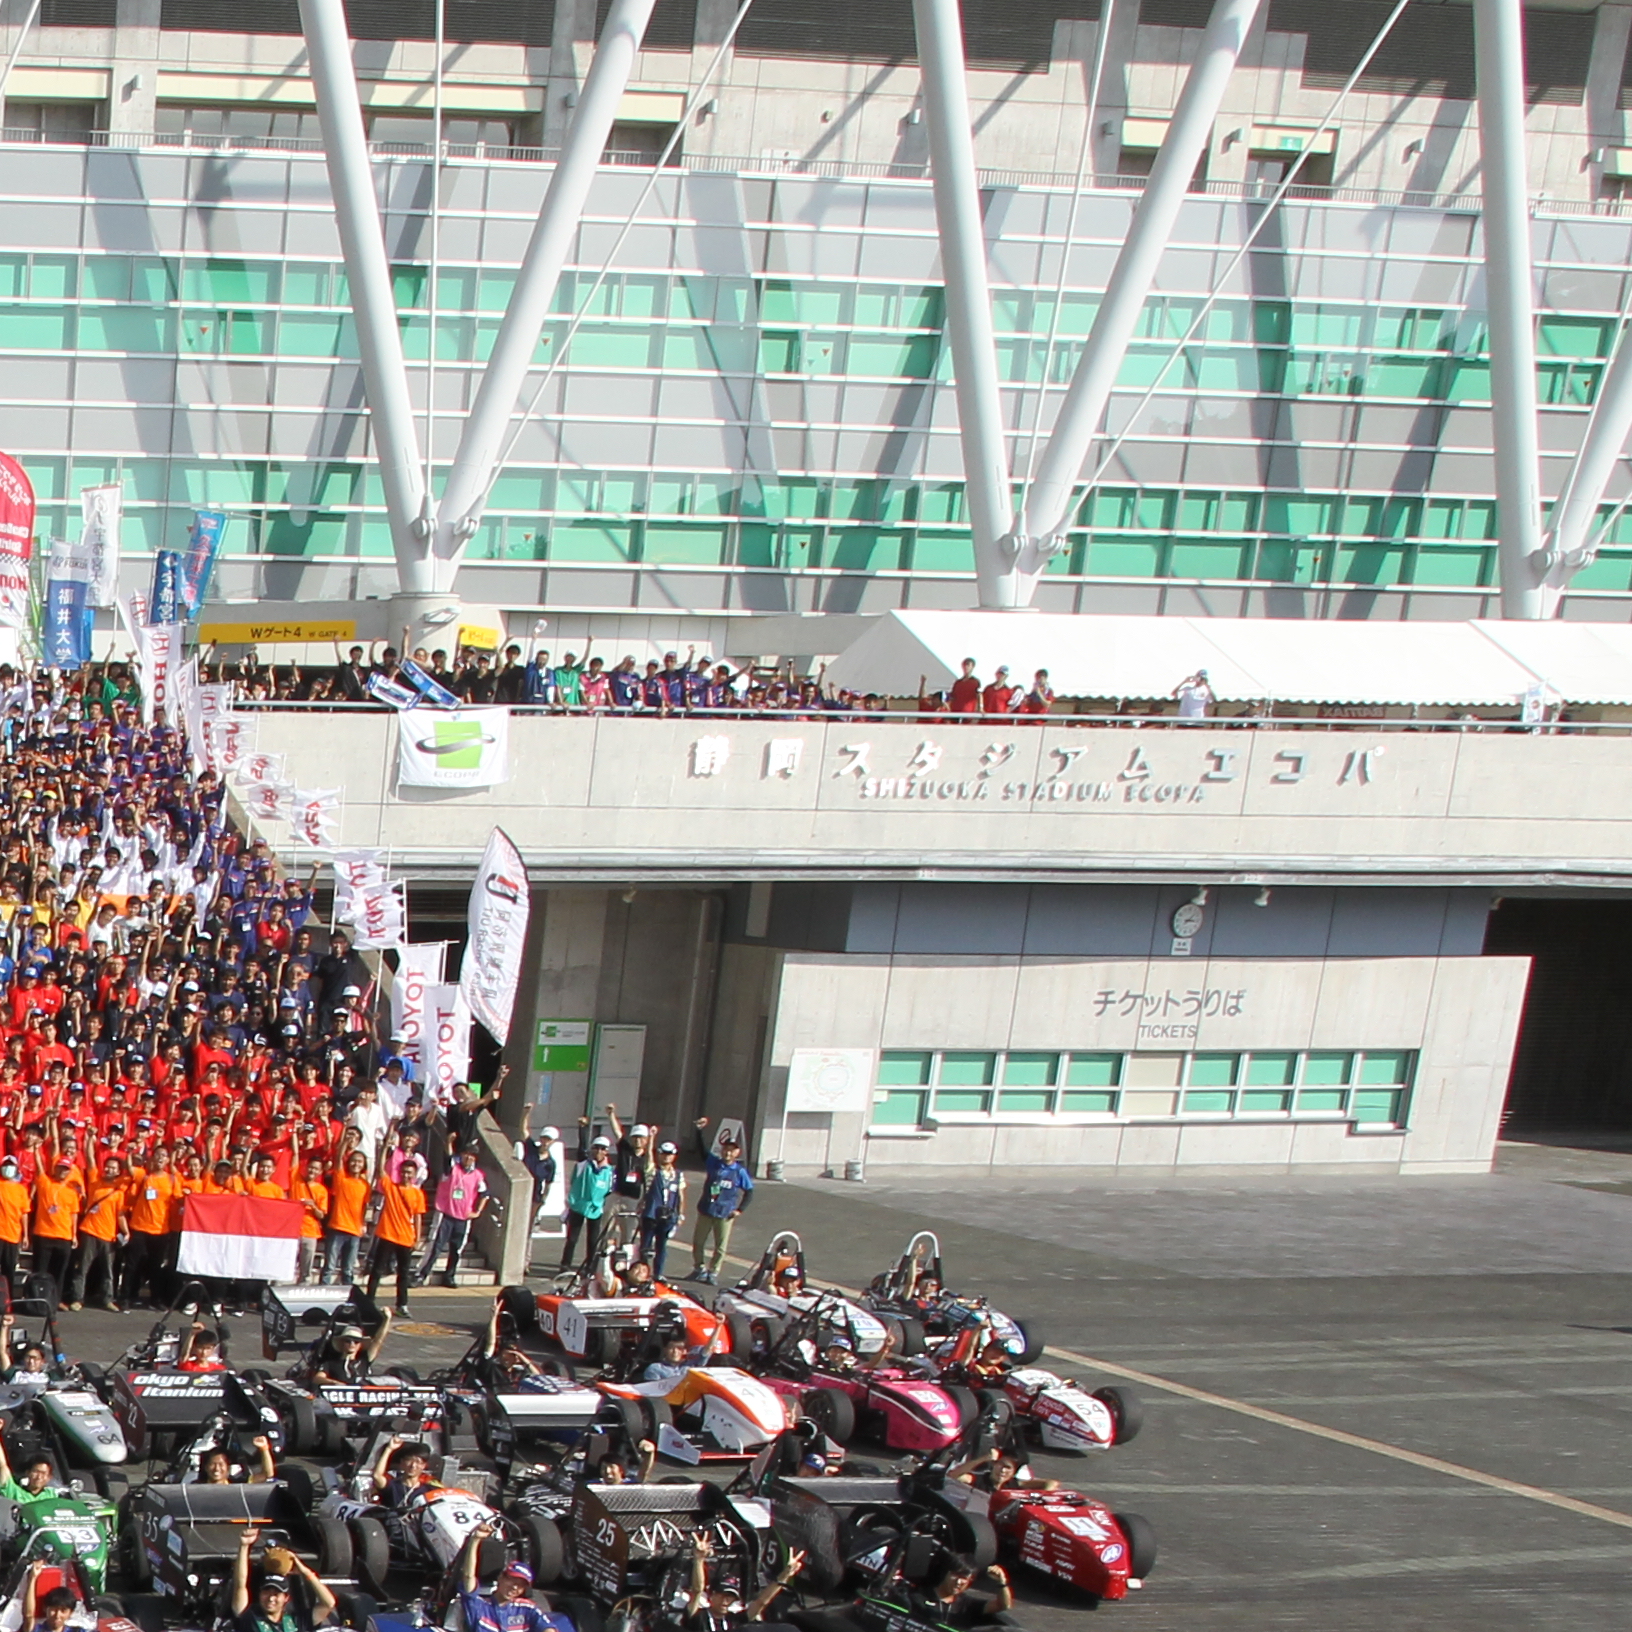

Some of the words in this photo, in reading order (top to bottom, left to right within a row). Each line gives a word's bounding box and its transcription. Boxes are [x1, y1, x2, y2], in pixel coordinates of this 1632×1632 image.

[55, 588, 73, 665] 福井大学
[250, 625, 302, 640] Wゲート4
[688, 737, 1386, 786] 静岡スタジアムエコパ
[859, 777, 990, 800] SHIZUOKA
[1000, 780, 1113, 803] STADIUM
[1123, 783, 1206, 804] ECOPA
[1093, 989, 1247, 1018] チケットうりば
[1138, 1024, 1197, 1039] TICKETS
[563, 1320, 578, 1338] 41
[1076, 1402, 1103, 1416] 54
[99, 1433, 124, 1444] 64
[597, 1518, 617, 1547] 25
